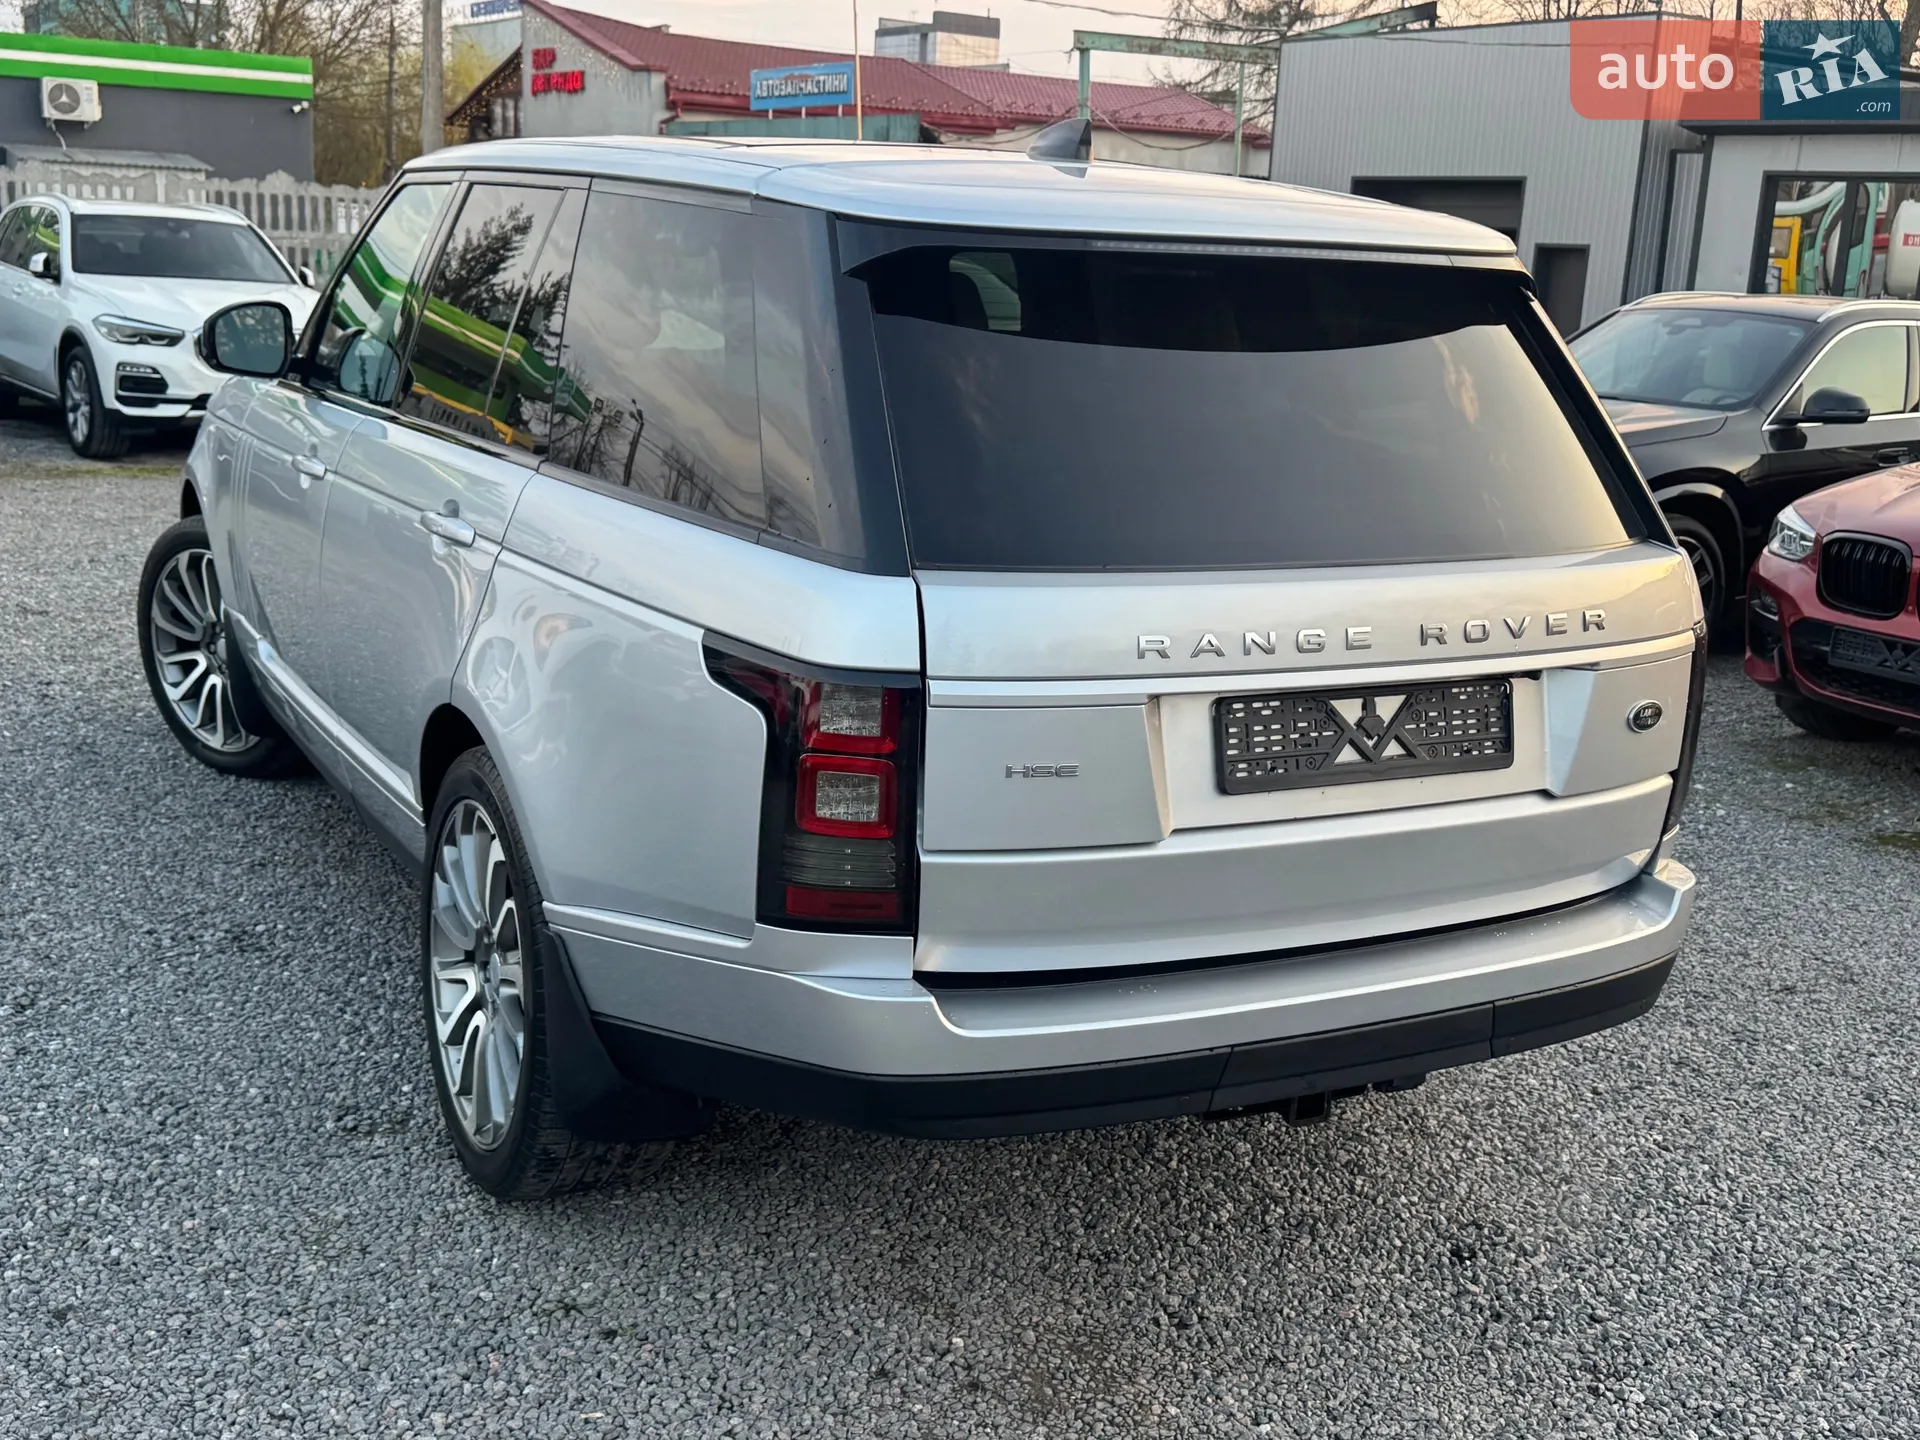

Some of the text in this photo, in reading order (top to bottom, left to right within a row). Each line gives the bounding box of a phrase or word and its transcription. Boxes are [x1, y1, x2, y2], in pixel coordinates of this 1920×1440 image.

[755, 73, 848, 99] АВТОЗАПЧАСТИНИ
[1137, 608, 1607, 660] RANGE ROVER
[1005, 763, 1079, 778] HSE
